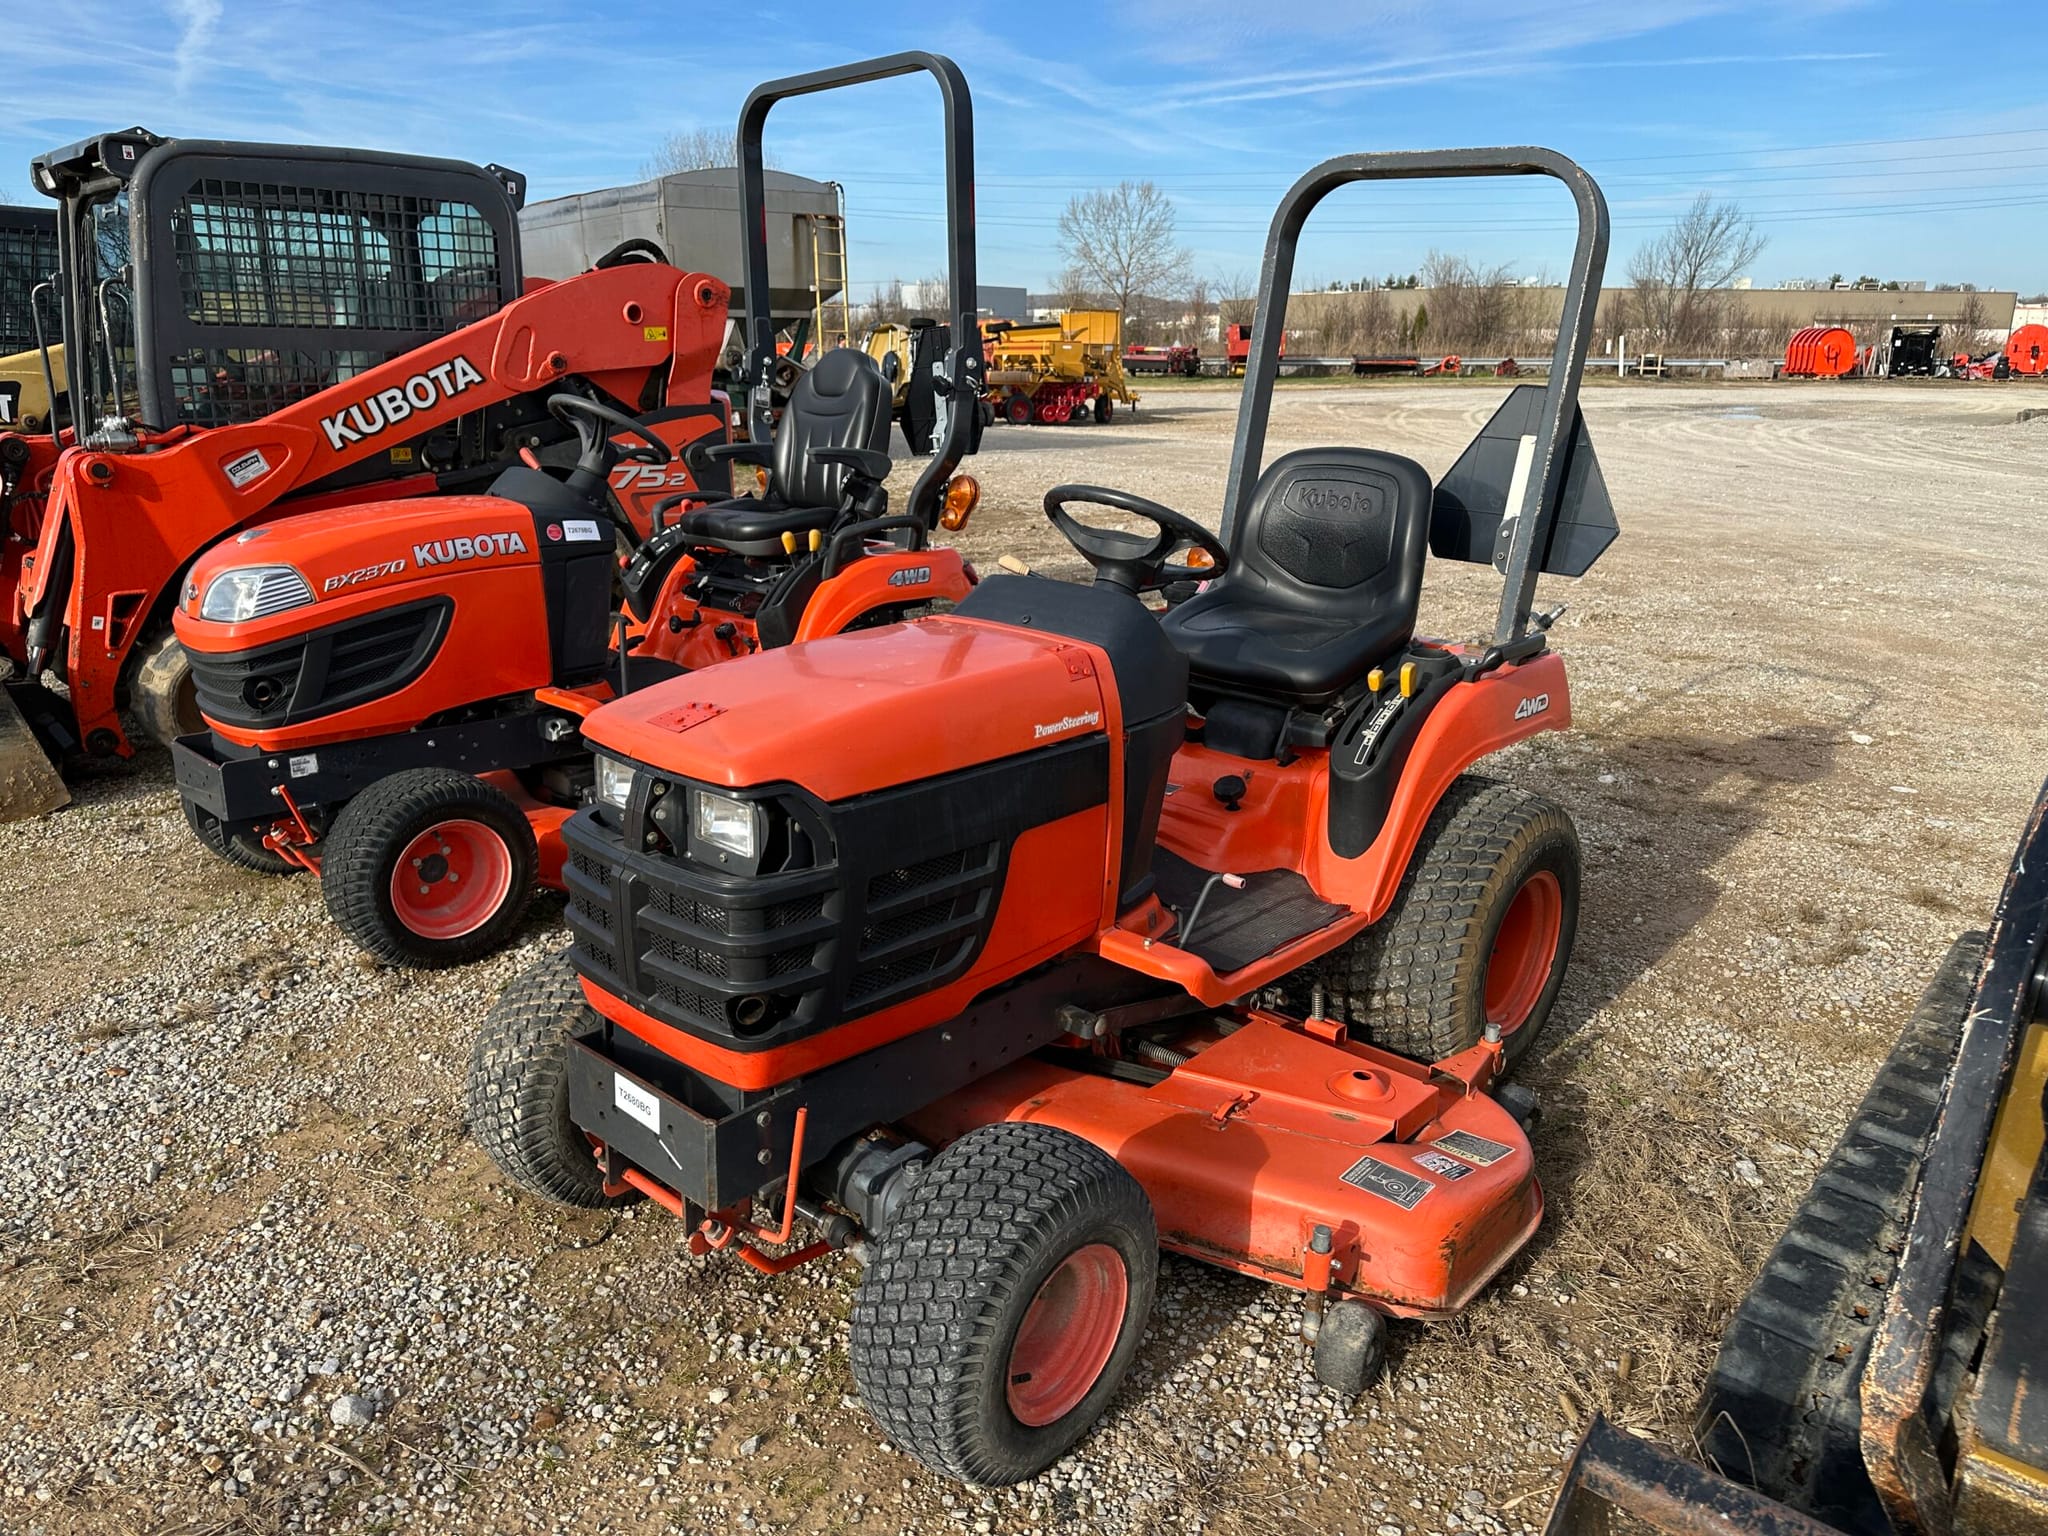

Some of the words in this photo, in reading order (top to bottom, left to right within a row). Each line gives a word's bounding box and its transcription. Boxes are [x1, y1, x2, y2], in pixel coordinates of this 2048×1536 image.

[320, 356, 484, 450] KUBOTA
[612, 464, 687, 489] 75-2
[1297, 487, 1372, 513] Kubota
[413, 532, 527, 568] KUBOTA
[323, 559, 405, 593] BX2370
[888, 567, 930, 586] 4WD
[1514, 693, 1549, 720] 4WD
[1034, 710, 1099, 739] PowerSteering
